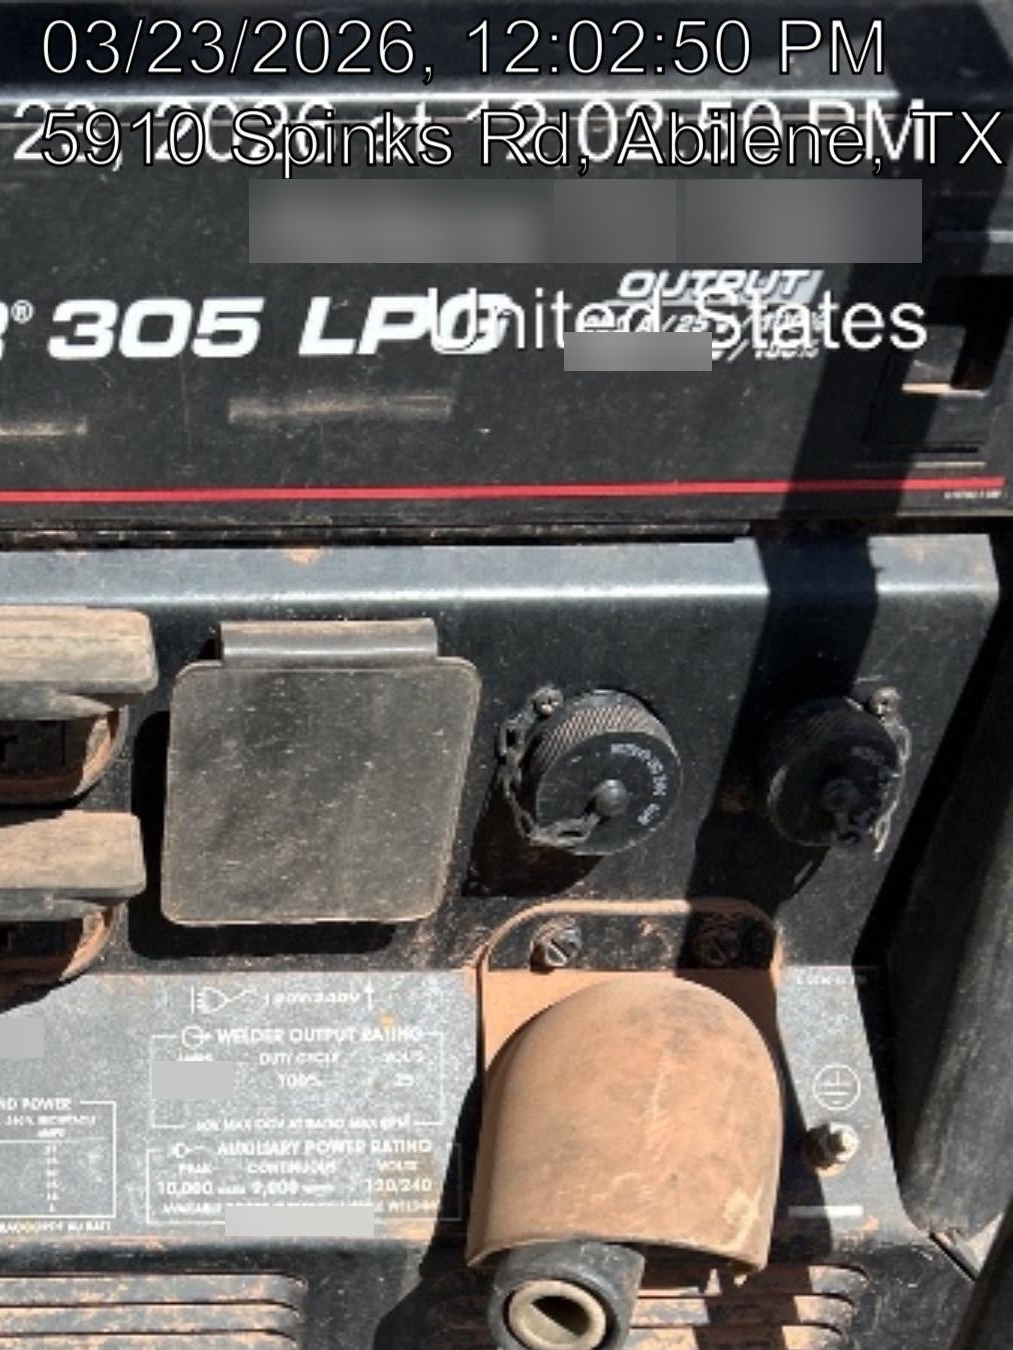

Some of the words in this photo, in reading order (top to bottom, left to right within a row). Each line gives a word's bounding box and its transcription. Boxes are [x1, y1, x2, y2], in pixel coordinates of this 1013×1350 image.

[617, 270, 813, 298] OUTPUT
[47, 297, 265, 359] 305
[298, 293, 515, 357] LPG
[215, 1027, 283, 1044] WELDER
[289, 1027, 358, 1042] OUTPUT
[361, 1026, 424, 1042] RATING
[22, 1097, 73, 1111] POWER
[217, 1141, 300, 1156] AUXILIARY
[304, 1140, 366, 1155] POWER
[370, 1139, 433, 1154] RATING
